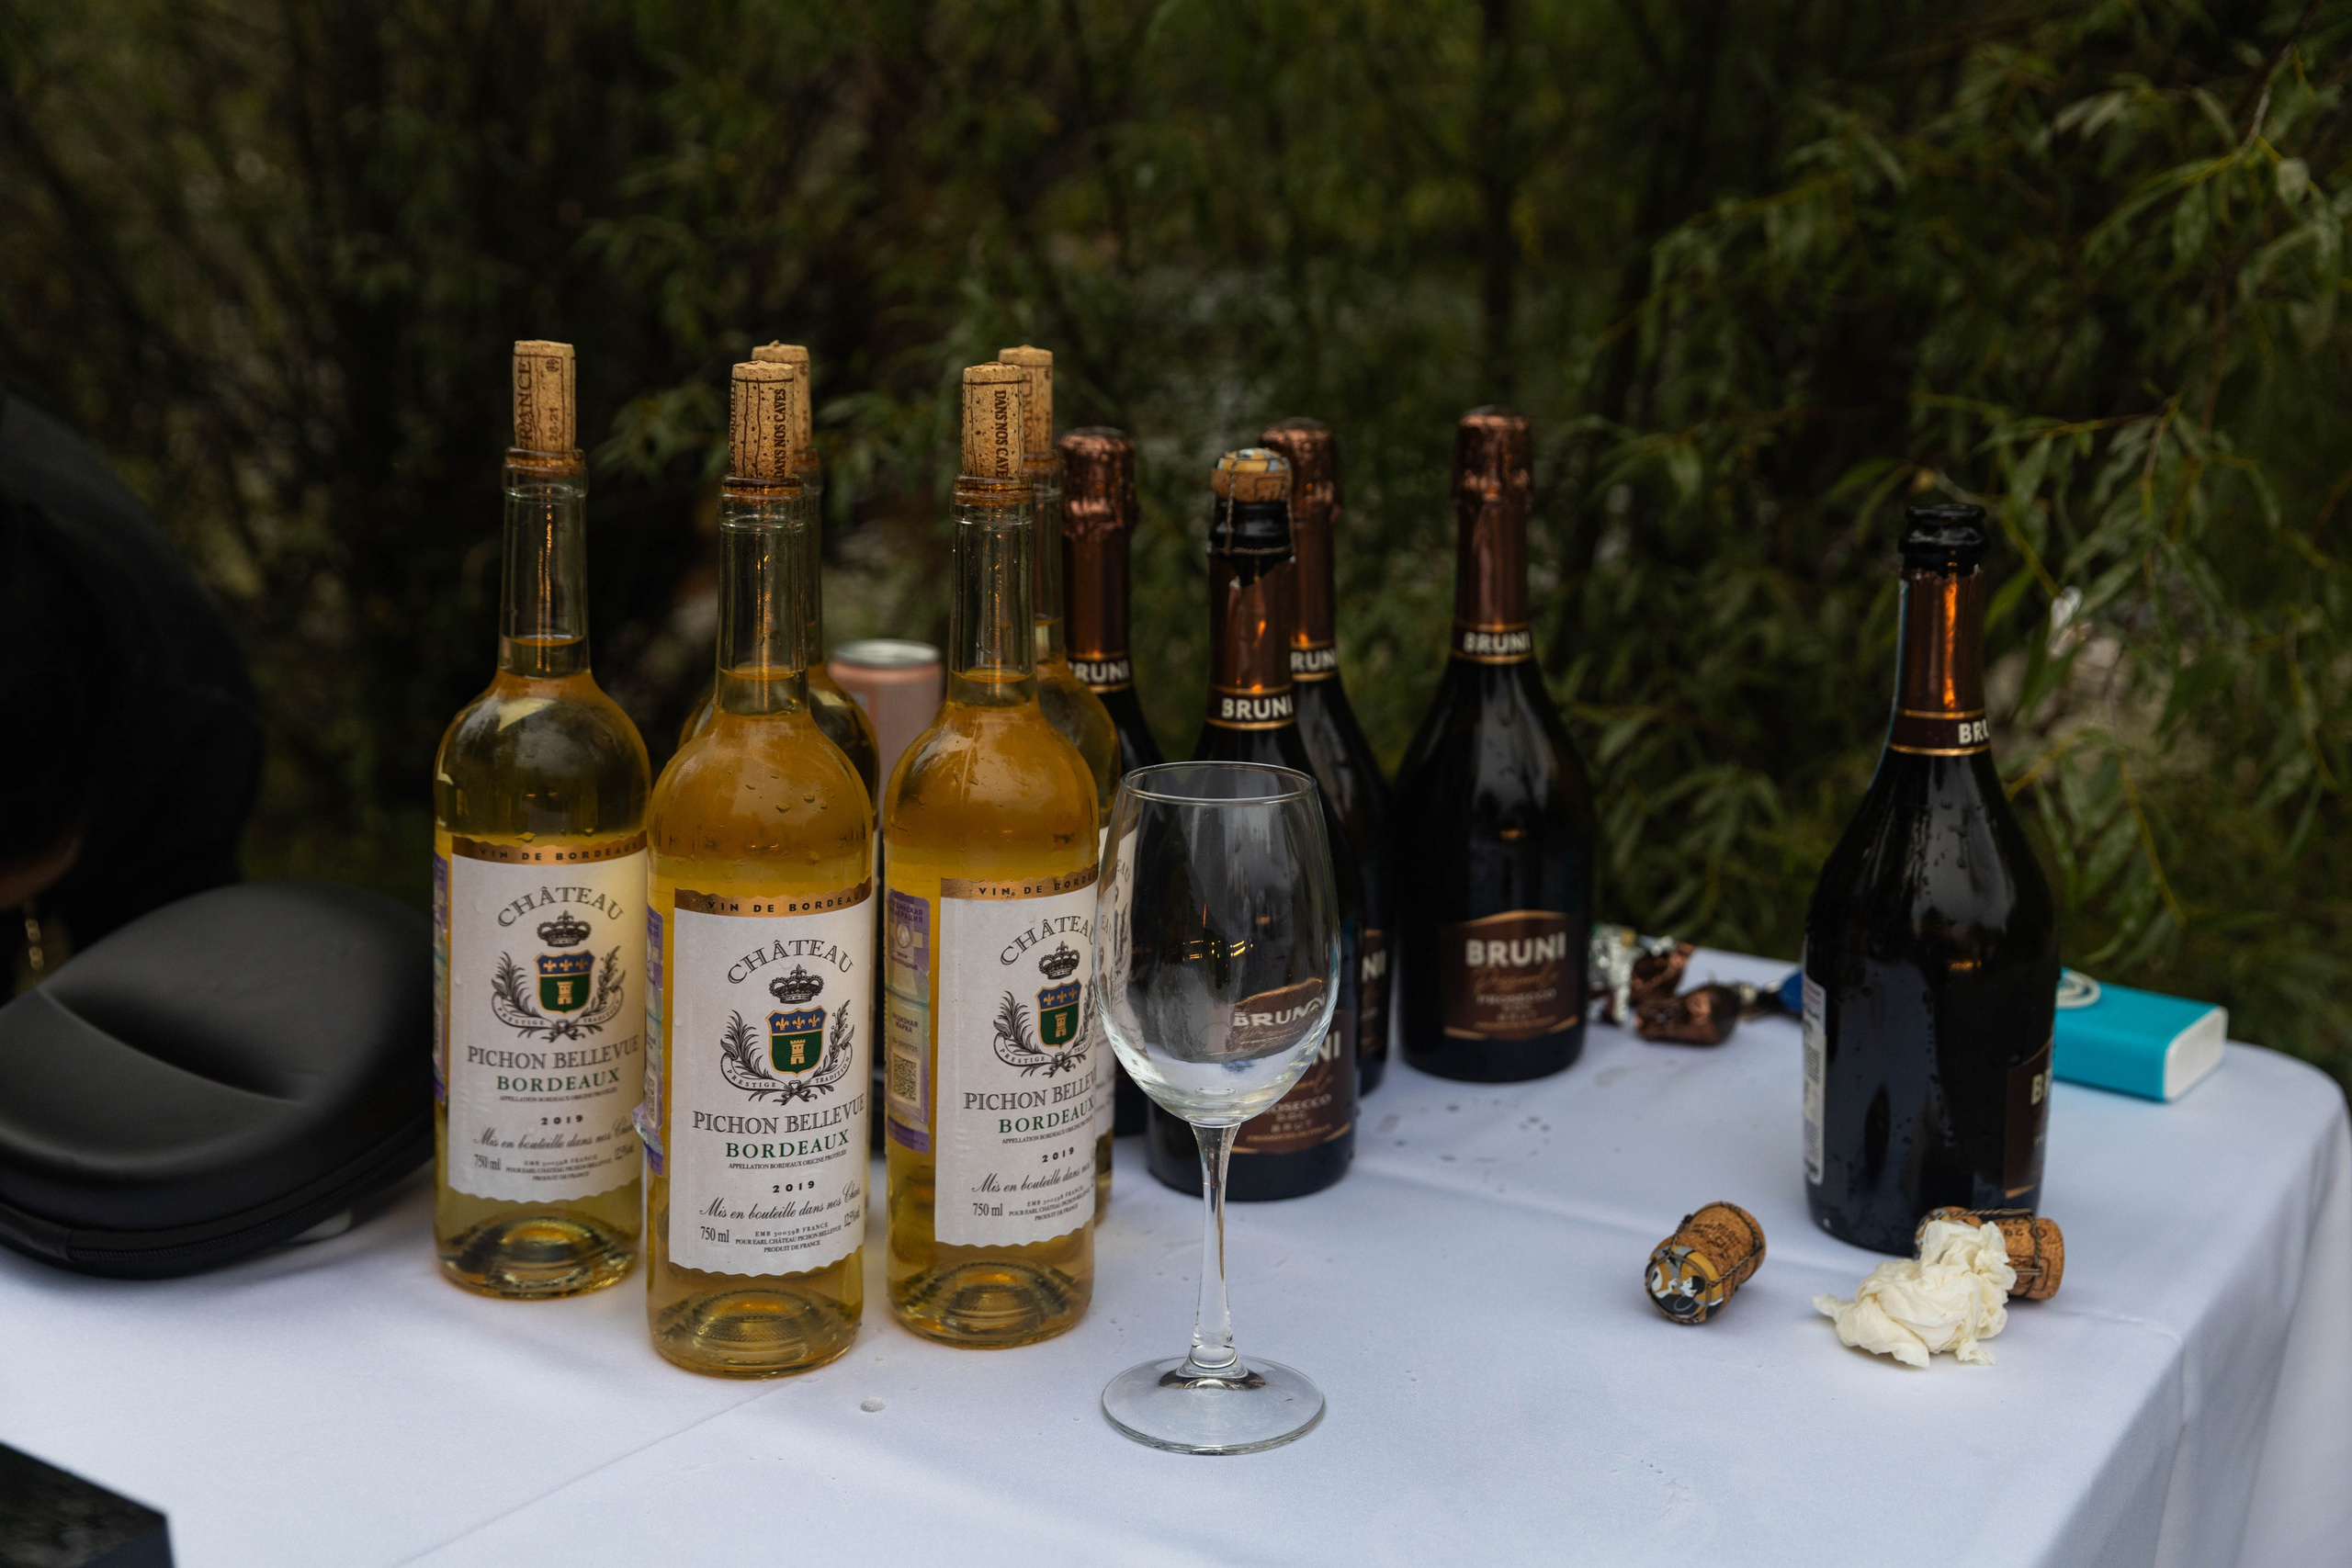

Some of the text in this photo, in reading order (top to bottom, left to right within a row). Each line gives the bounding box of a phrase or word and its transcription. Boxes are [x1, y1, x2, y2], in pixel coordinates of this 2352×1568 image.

[774, 388, 786, 478] DANS NOS CAVES
[994, 390, 1009, 479] DANS NOS CAVE
[1463, 631, 1532, 654] BRUNI
[1290, 649, 1337, 672] RUN
[1221, 694, 1293, 719] BRUNI
[1958, 719, 1991, 745] BRU
[521, 852, 542, 862] DE
[978, 873, 1092, 896] VIN DE BORDE
[497, 886, 625, 927] CHÂTEAU
[707, 890, 865, 913] VIN DE BORDEAUX
[1465, 931, 1566, 967] BRUNI
[728, 939, 854, 984] CHÂTEAU
[467, 1045, 548, 1069] PICHON
[552, 1034, 640, 1068] BELLEVUE
[1000, 1048, 1046, 1064] PRESTIGE
[496, 1067, 621, 1092] BORDEAUX
[727, 1069, 777, 1089] PRESTIGE
[815, 1056, 850, 1084] TRADITION
[963, 1066, 1096, 1111] PICHON BELLEV
[540, 1114, 583, 1125] 2019
[692, 1092, 865, 1135] PICHON BELLEVUE
[999, 1094, 1095, 1134] BORDEAUX
[473, 1127, 499, 1147] Mis
[501, 1140, 514, 1148] en
[517, 1134, 564, 1149] bouteille
[725, 1128, 850, 1159] BORDEAUX
[1001, 1134, 1039, 1145] APPELLATION
[1039, 1129, 1066, 1141] BORDEAUX
[473, 1154, 502, 1171] 750 ml
[770, 1160, 802, 1169] BORDEAUX
[1041, 1146, 1075, 1163] 2019
[772, 1179, 816, 1194] 2019
[971, 1172, 1001, 1192] Mis
[1003, 1182, 1017, 1192] en
[1020, 1168, 1061, 1190] bouteille
[1062, 1166, 1080, 1182] dans
[699, 1197, 727, 1219] Mis
[729, 1210, 745, 1220] en
[748, 1201, 797, 1221] bouteille
[798, 1201, 824, 1216] dans
[826, 1196, 842, 1211] nos
[972, 1202, 1003, 1217] 750 ml
[700, 1225, 730, 1243] 750 ml
[769, 1235, 797, 1245] CHÂTEAU
[797, 1232, 819, 1242] PICHON
[818, 1224, 842, 1238] BELLEVUE
[802, 1221, 830, 1234] FRANCE
[763, 1245, 790, 1253] PRODUIT
[799, 1240, 821, 1250] FRANCE
